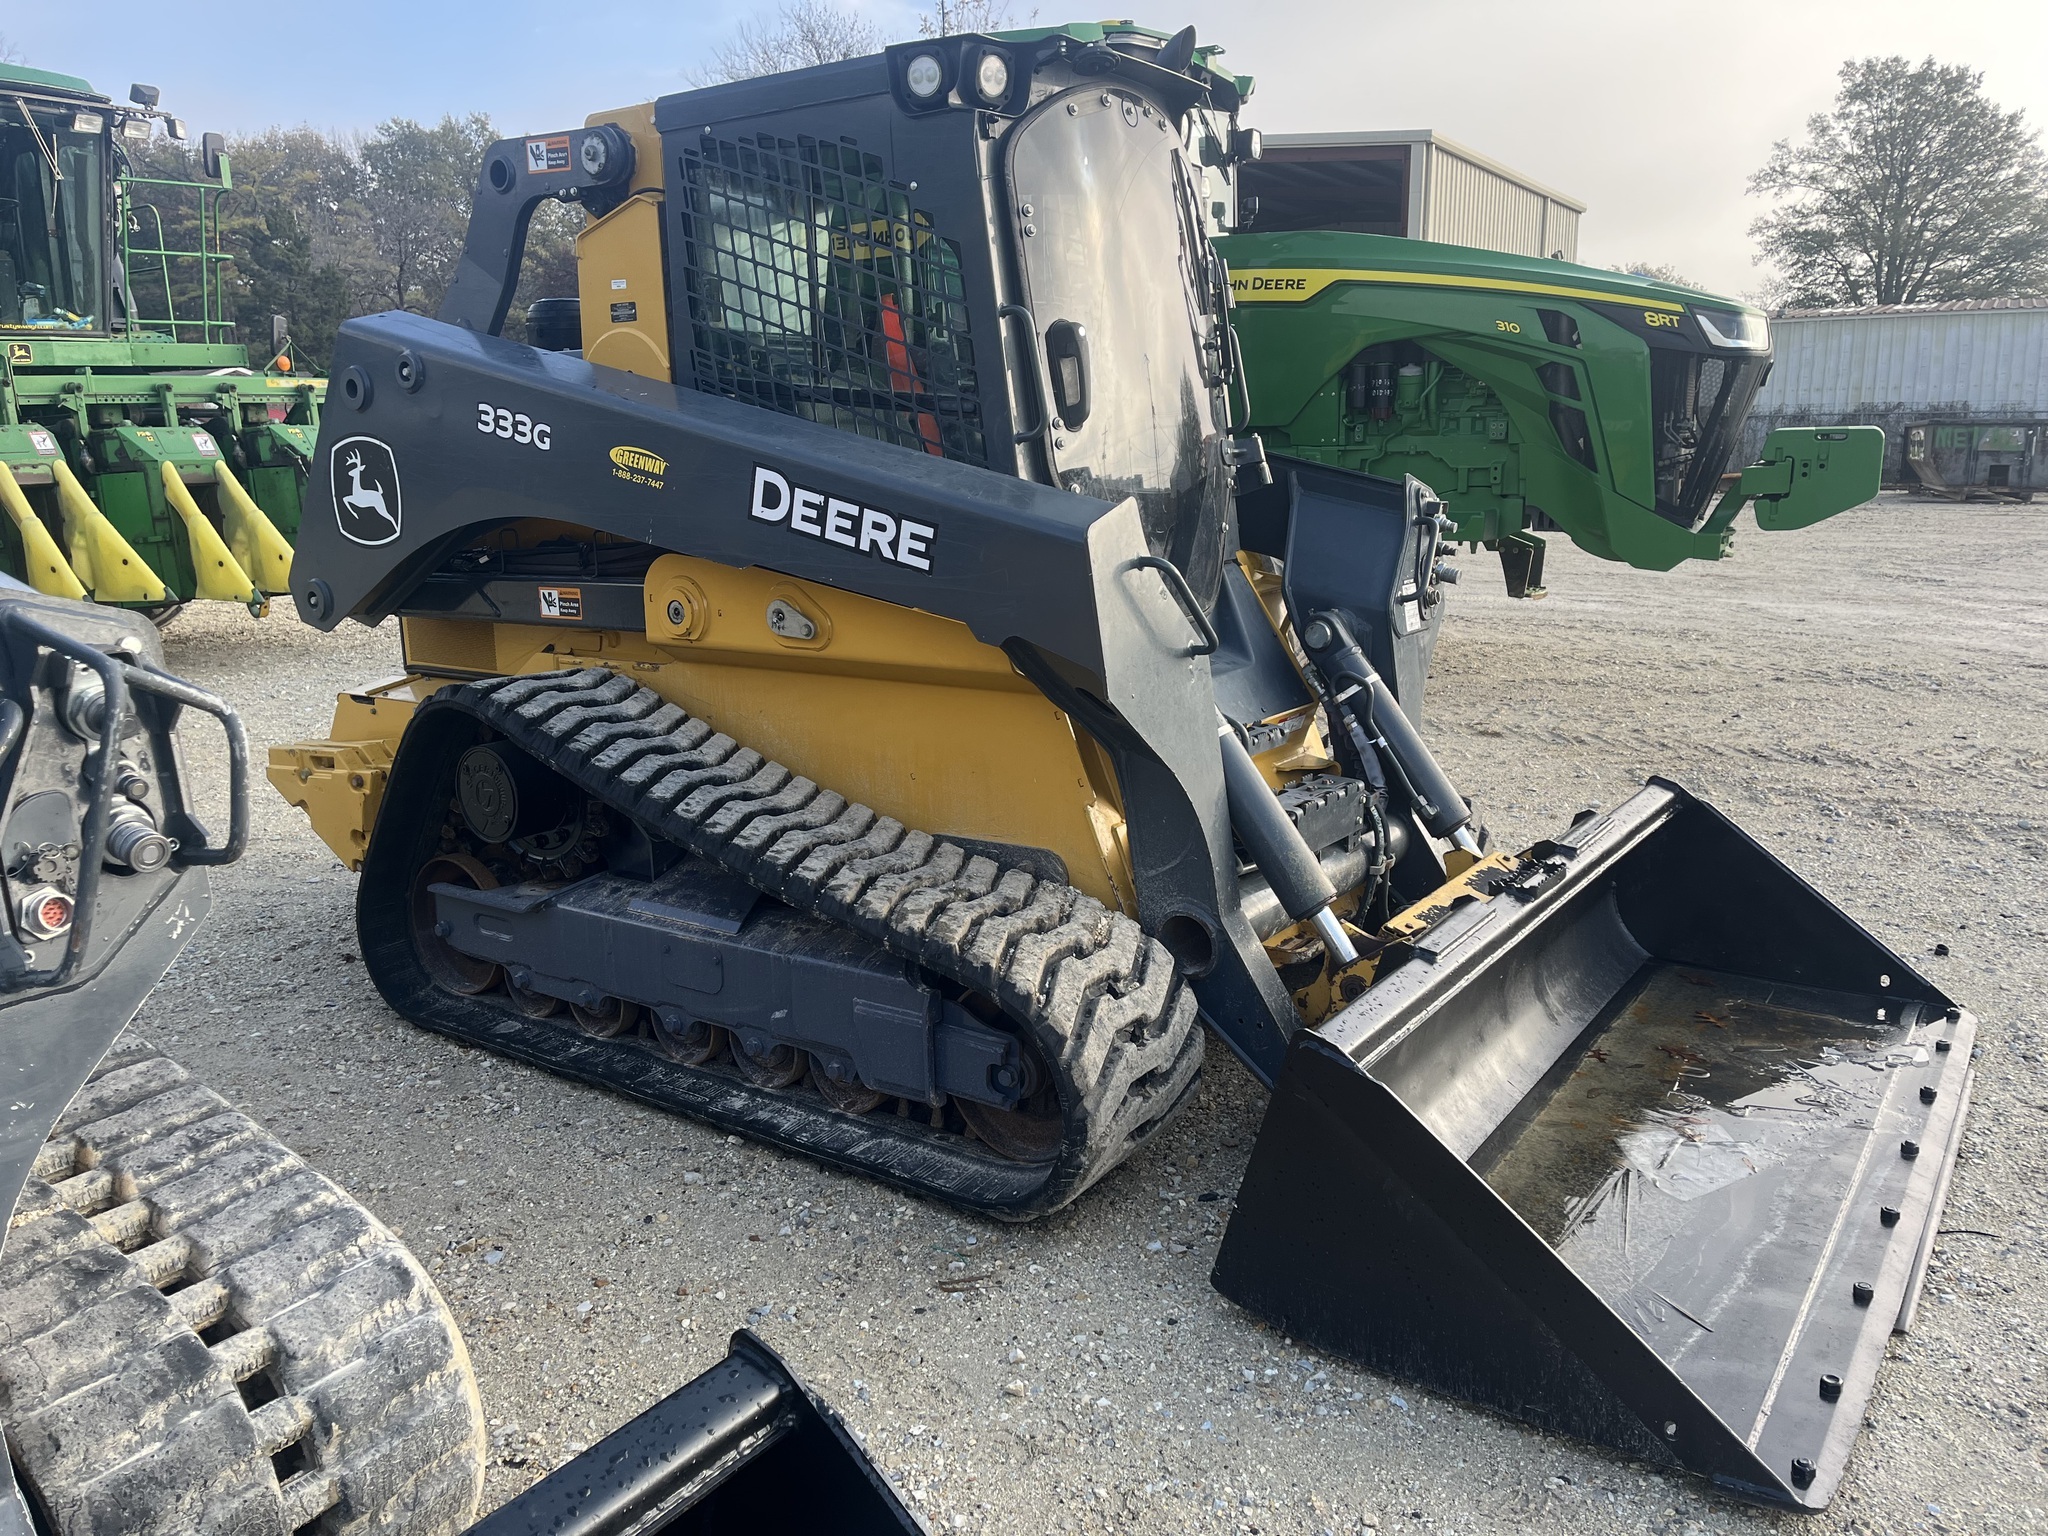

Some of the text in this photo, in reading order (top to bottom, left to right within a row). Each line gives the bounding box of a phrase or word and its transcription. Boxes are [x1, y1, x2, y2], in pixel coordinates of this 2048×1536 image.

[1252, 276, 1307, 290] DEERE
[1495, 320, 1521, 334] 310
[1644, 311, 1680, 328] 8RT
[477, 403, 551, 450] 333G
[616, 449, 667, 476] GREENWAY
[612, 468, 664, 490] 1-888-237-7447
[751, 466, 935, 571] DEERE
